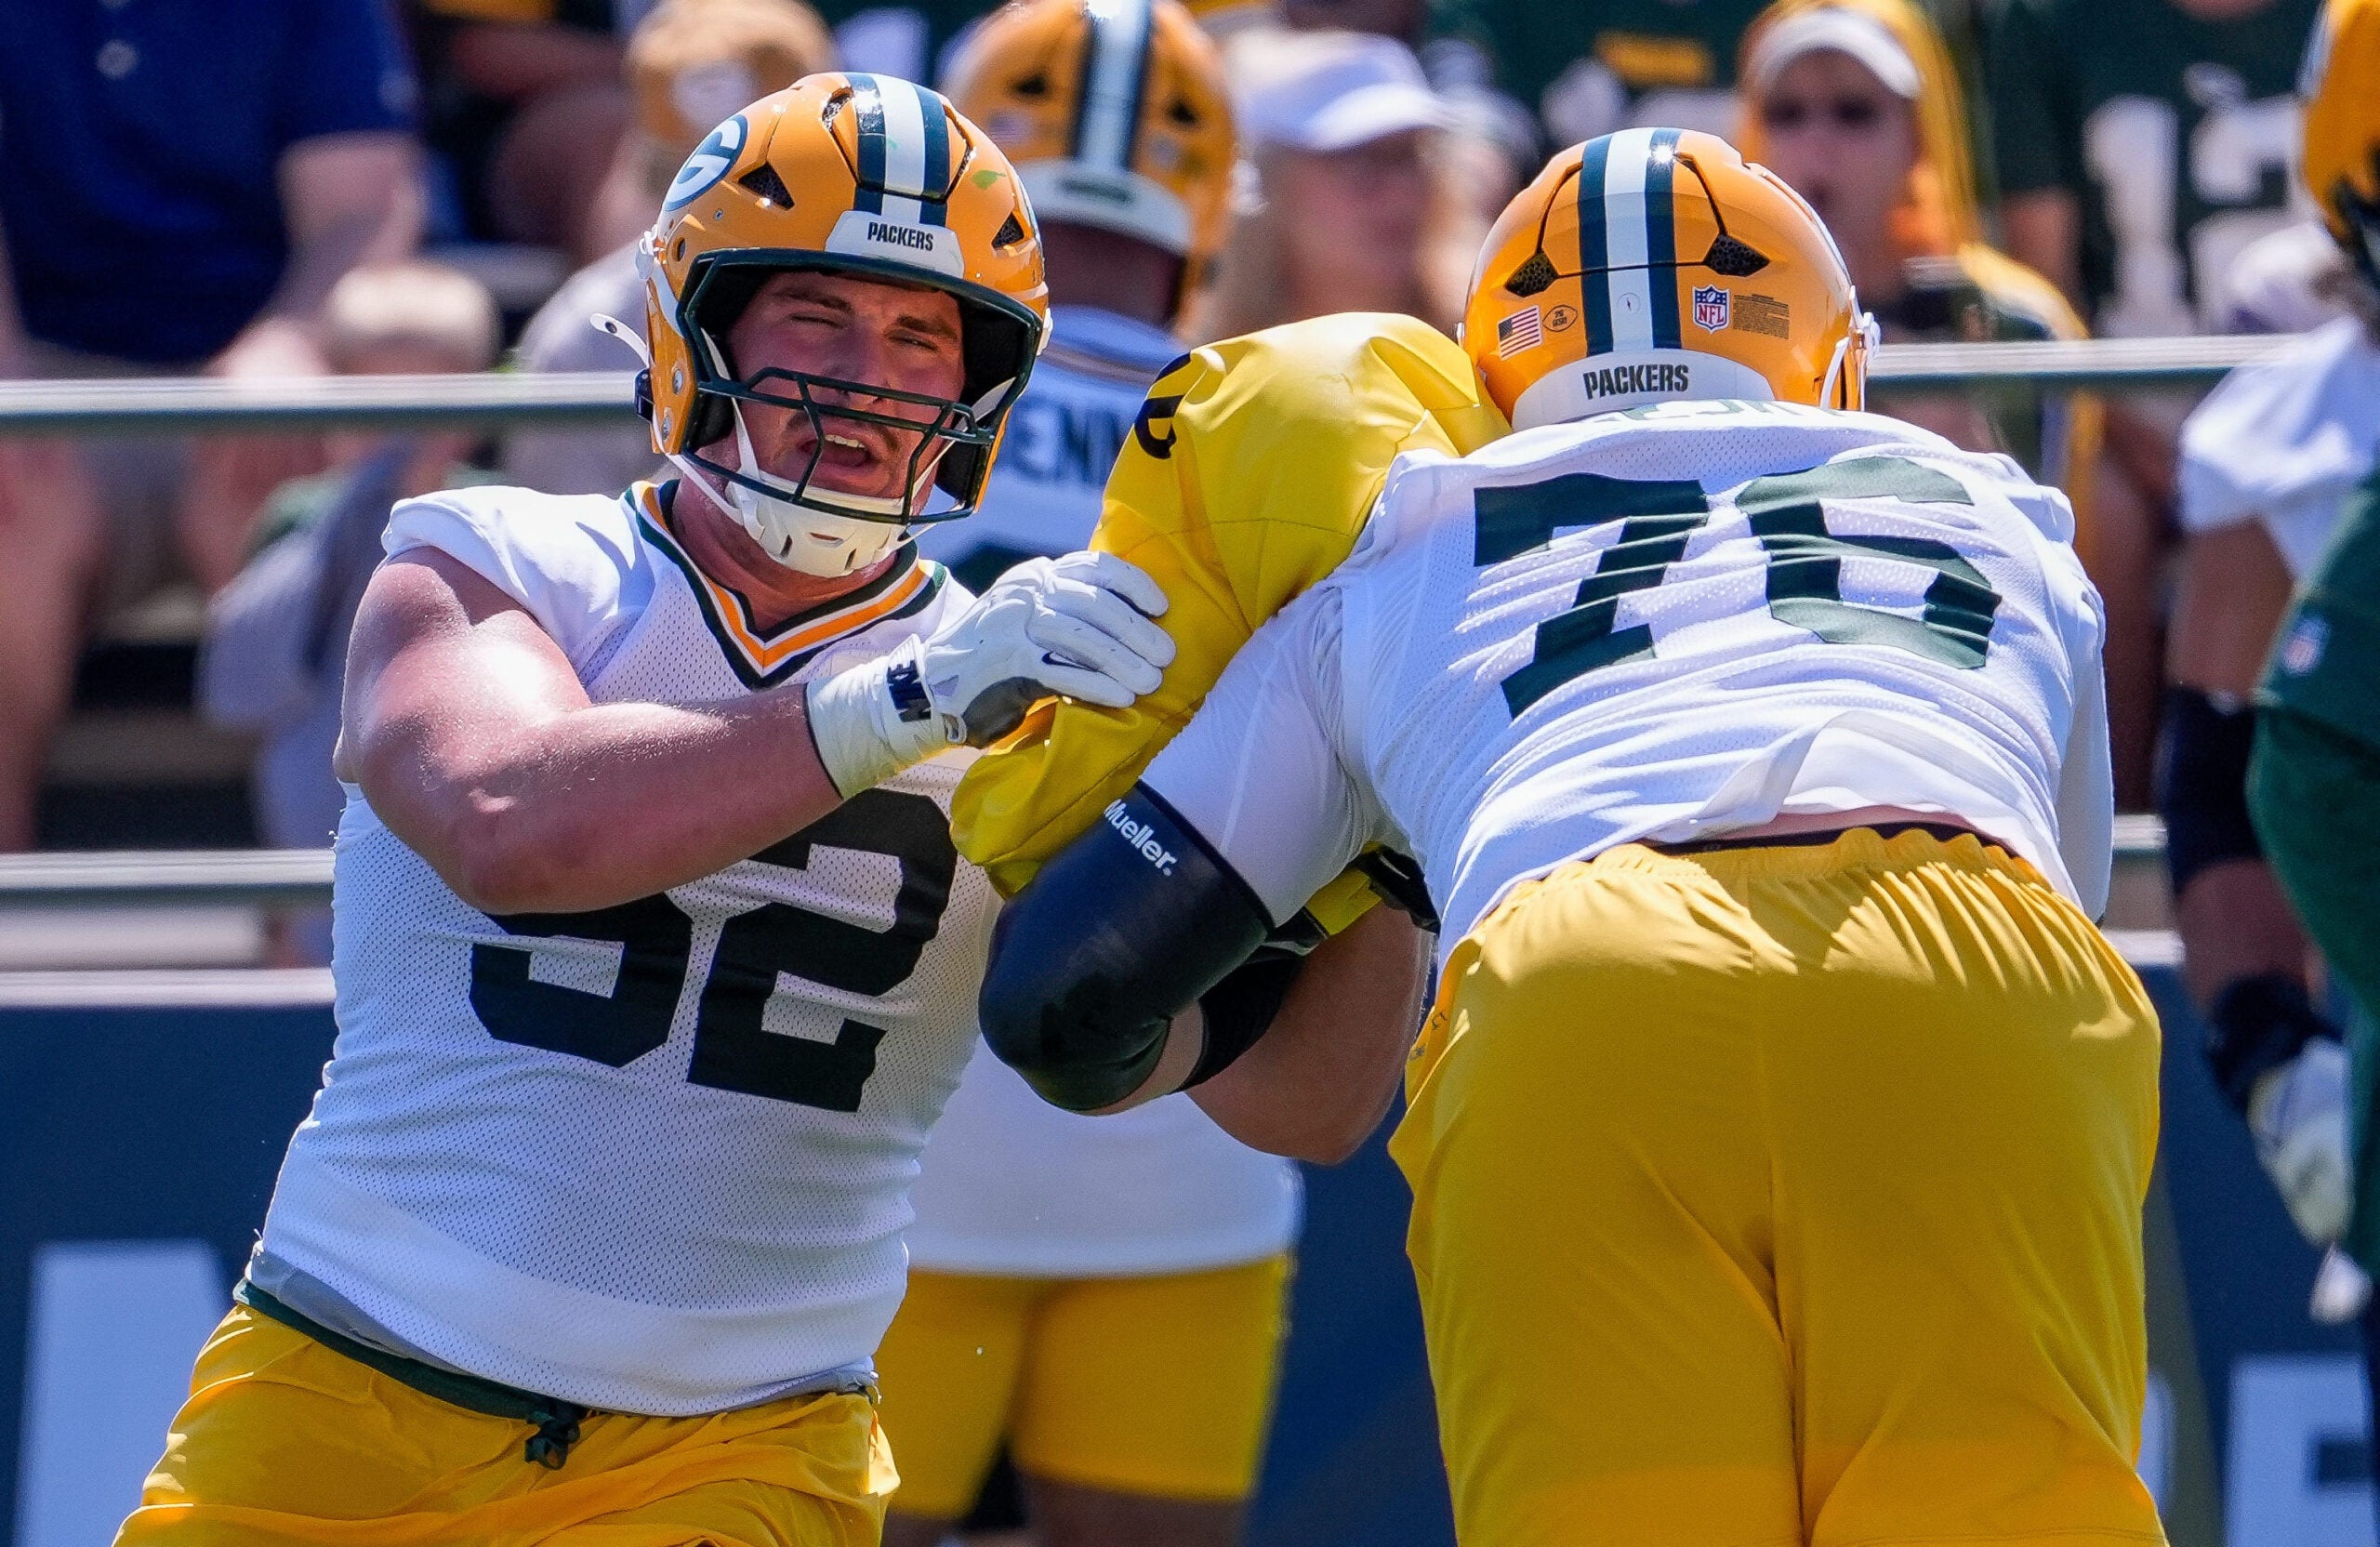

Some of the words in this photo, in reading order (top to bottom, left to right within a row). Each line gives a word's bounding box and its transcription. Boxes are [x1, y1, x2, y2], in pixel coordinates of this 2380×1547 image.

[867, 221, 934, 251] PACKERS
[1698, 304, 1725, 325] NFL
[1582, 364, 1690, 400] PACKERS
[1473, 456, 2002, 721] 76
